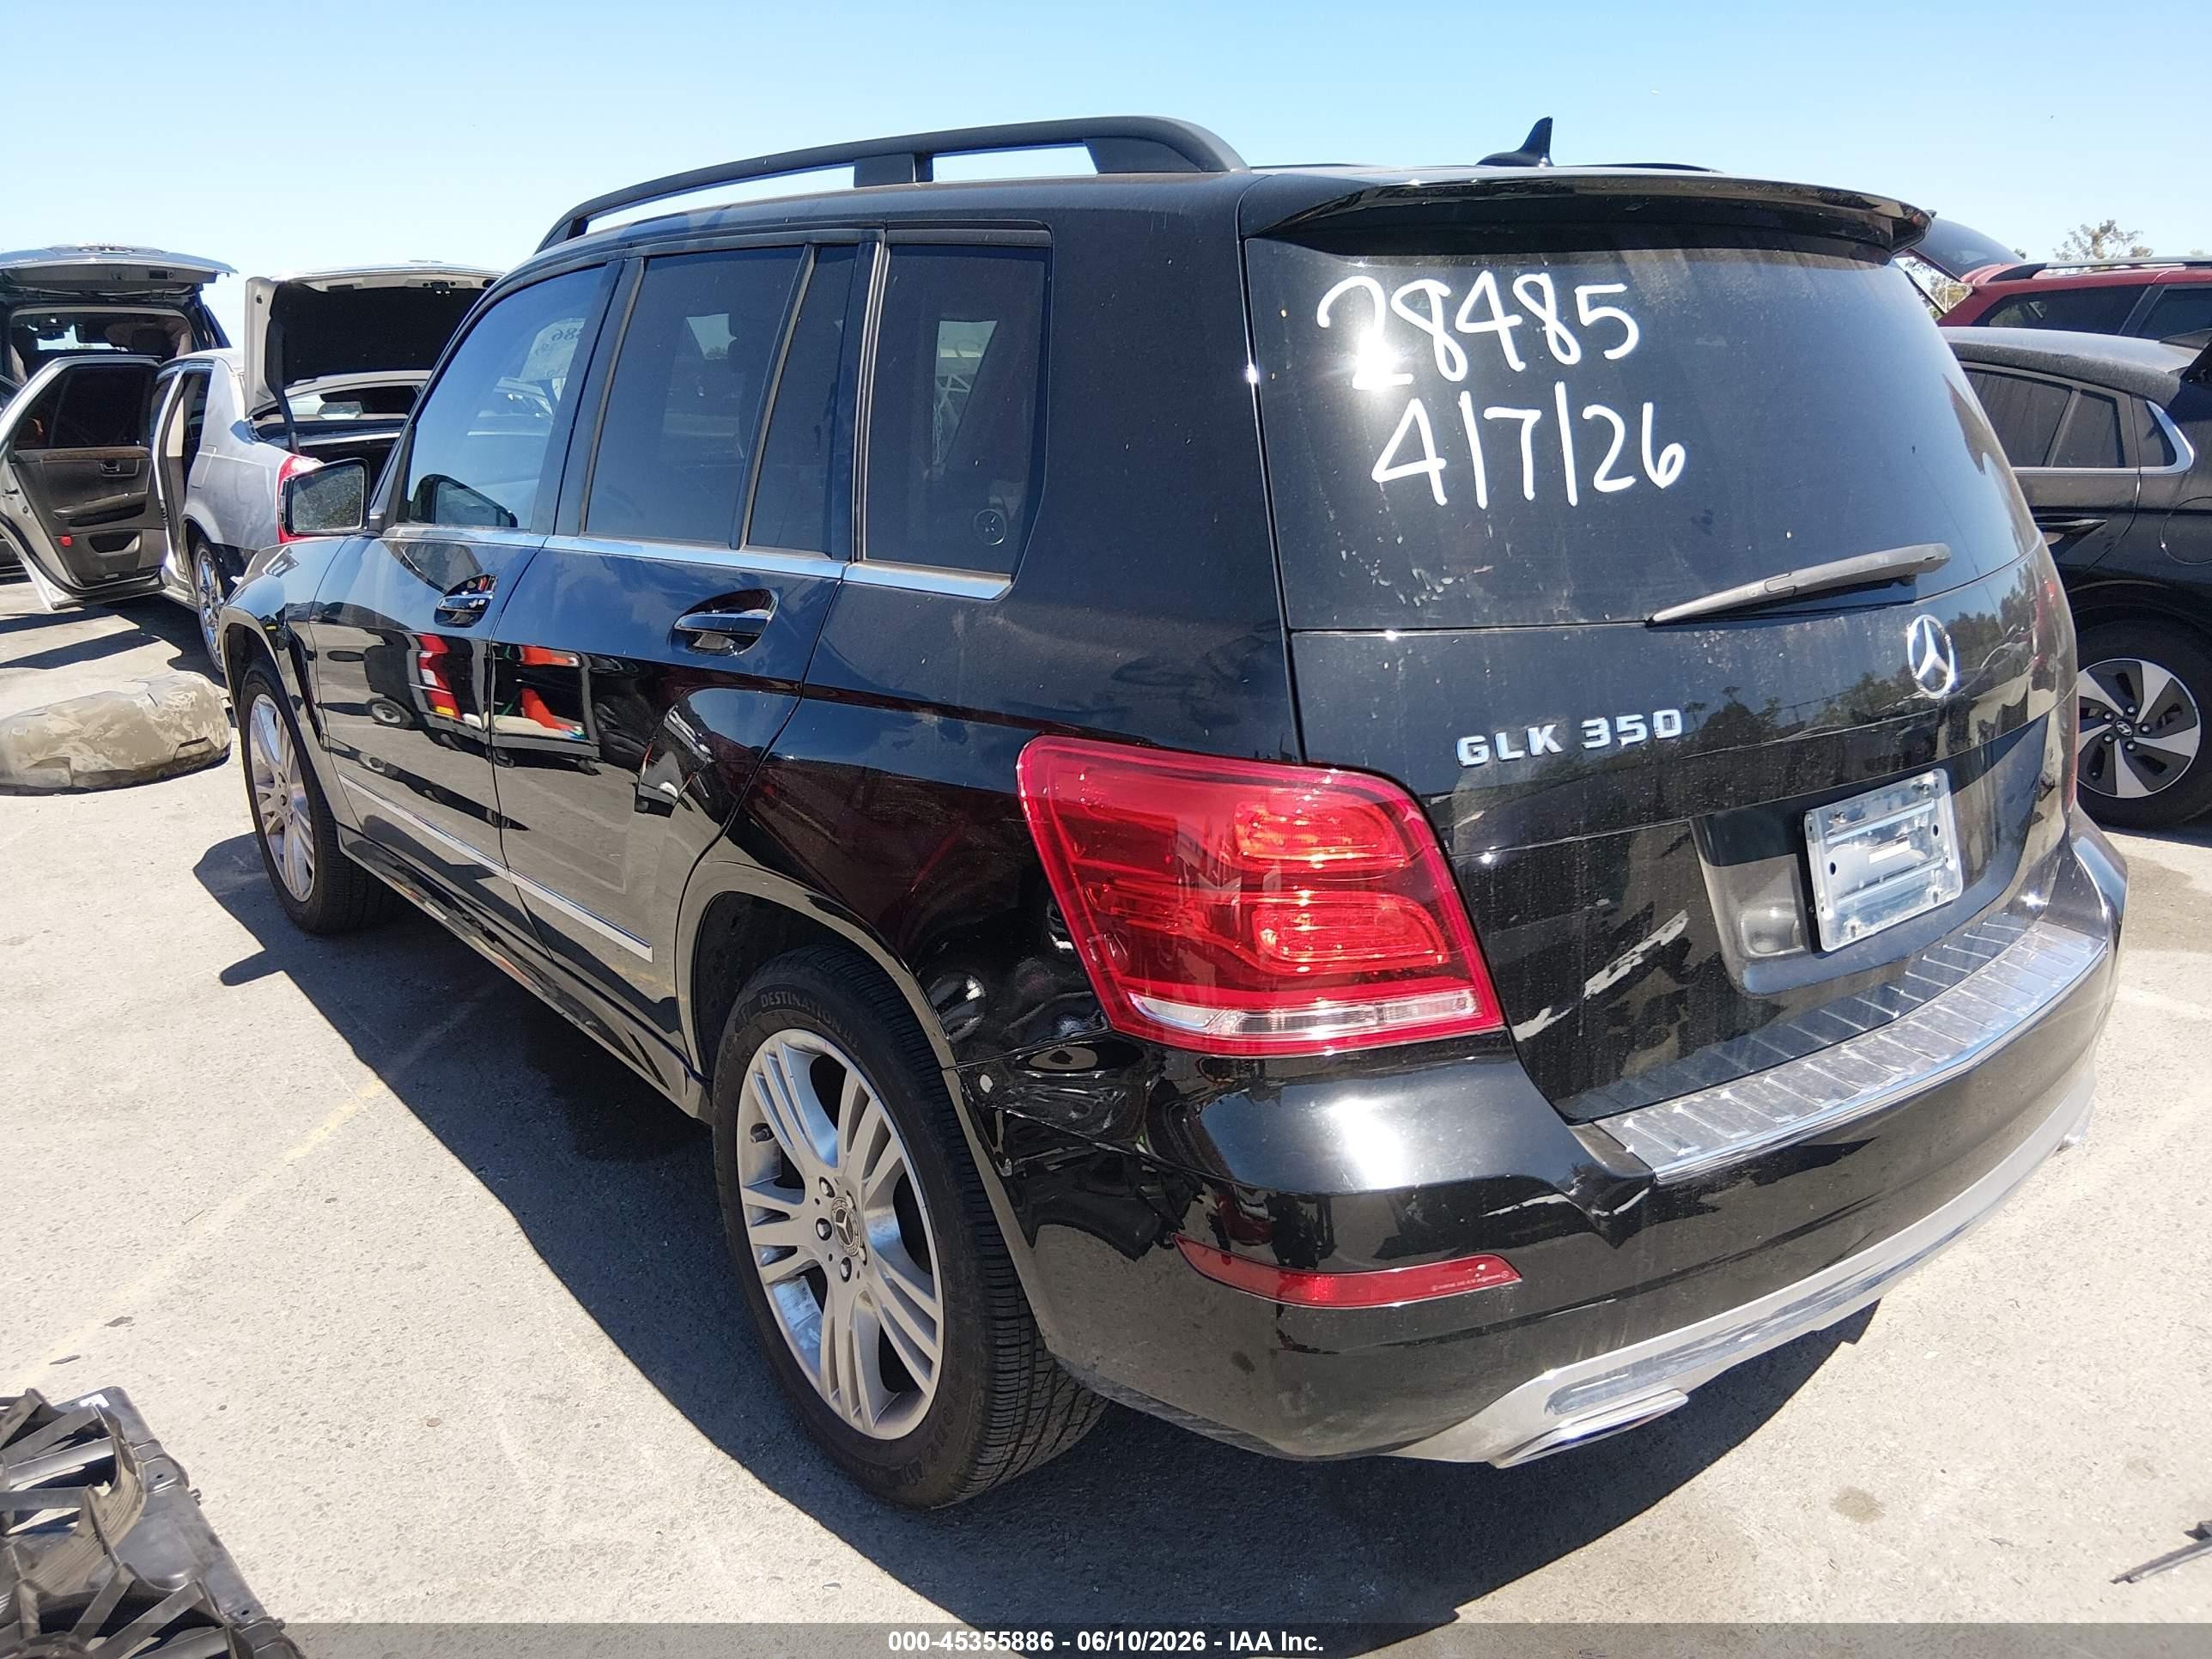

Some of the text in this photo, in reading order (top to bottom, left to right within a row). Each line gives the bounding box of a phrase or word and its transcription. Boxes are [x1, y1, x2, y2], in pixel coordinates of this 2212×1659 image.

[1317, 270, 1639, 389] 28485
[1456, 709, 1683, 767] GLK 350
